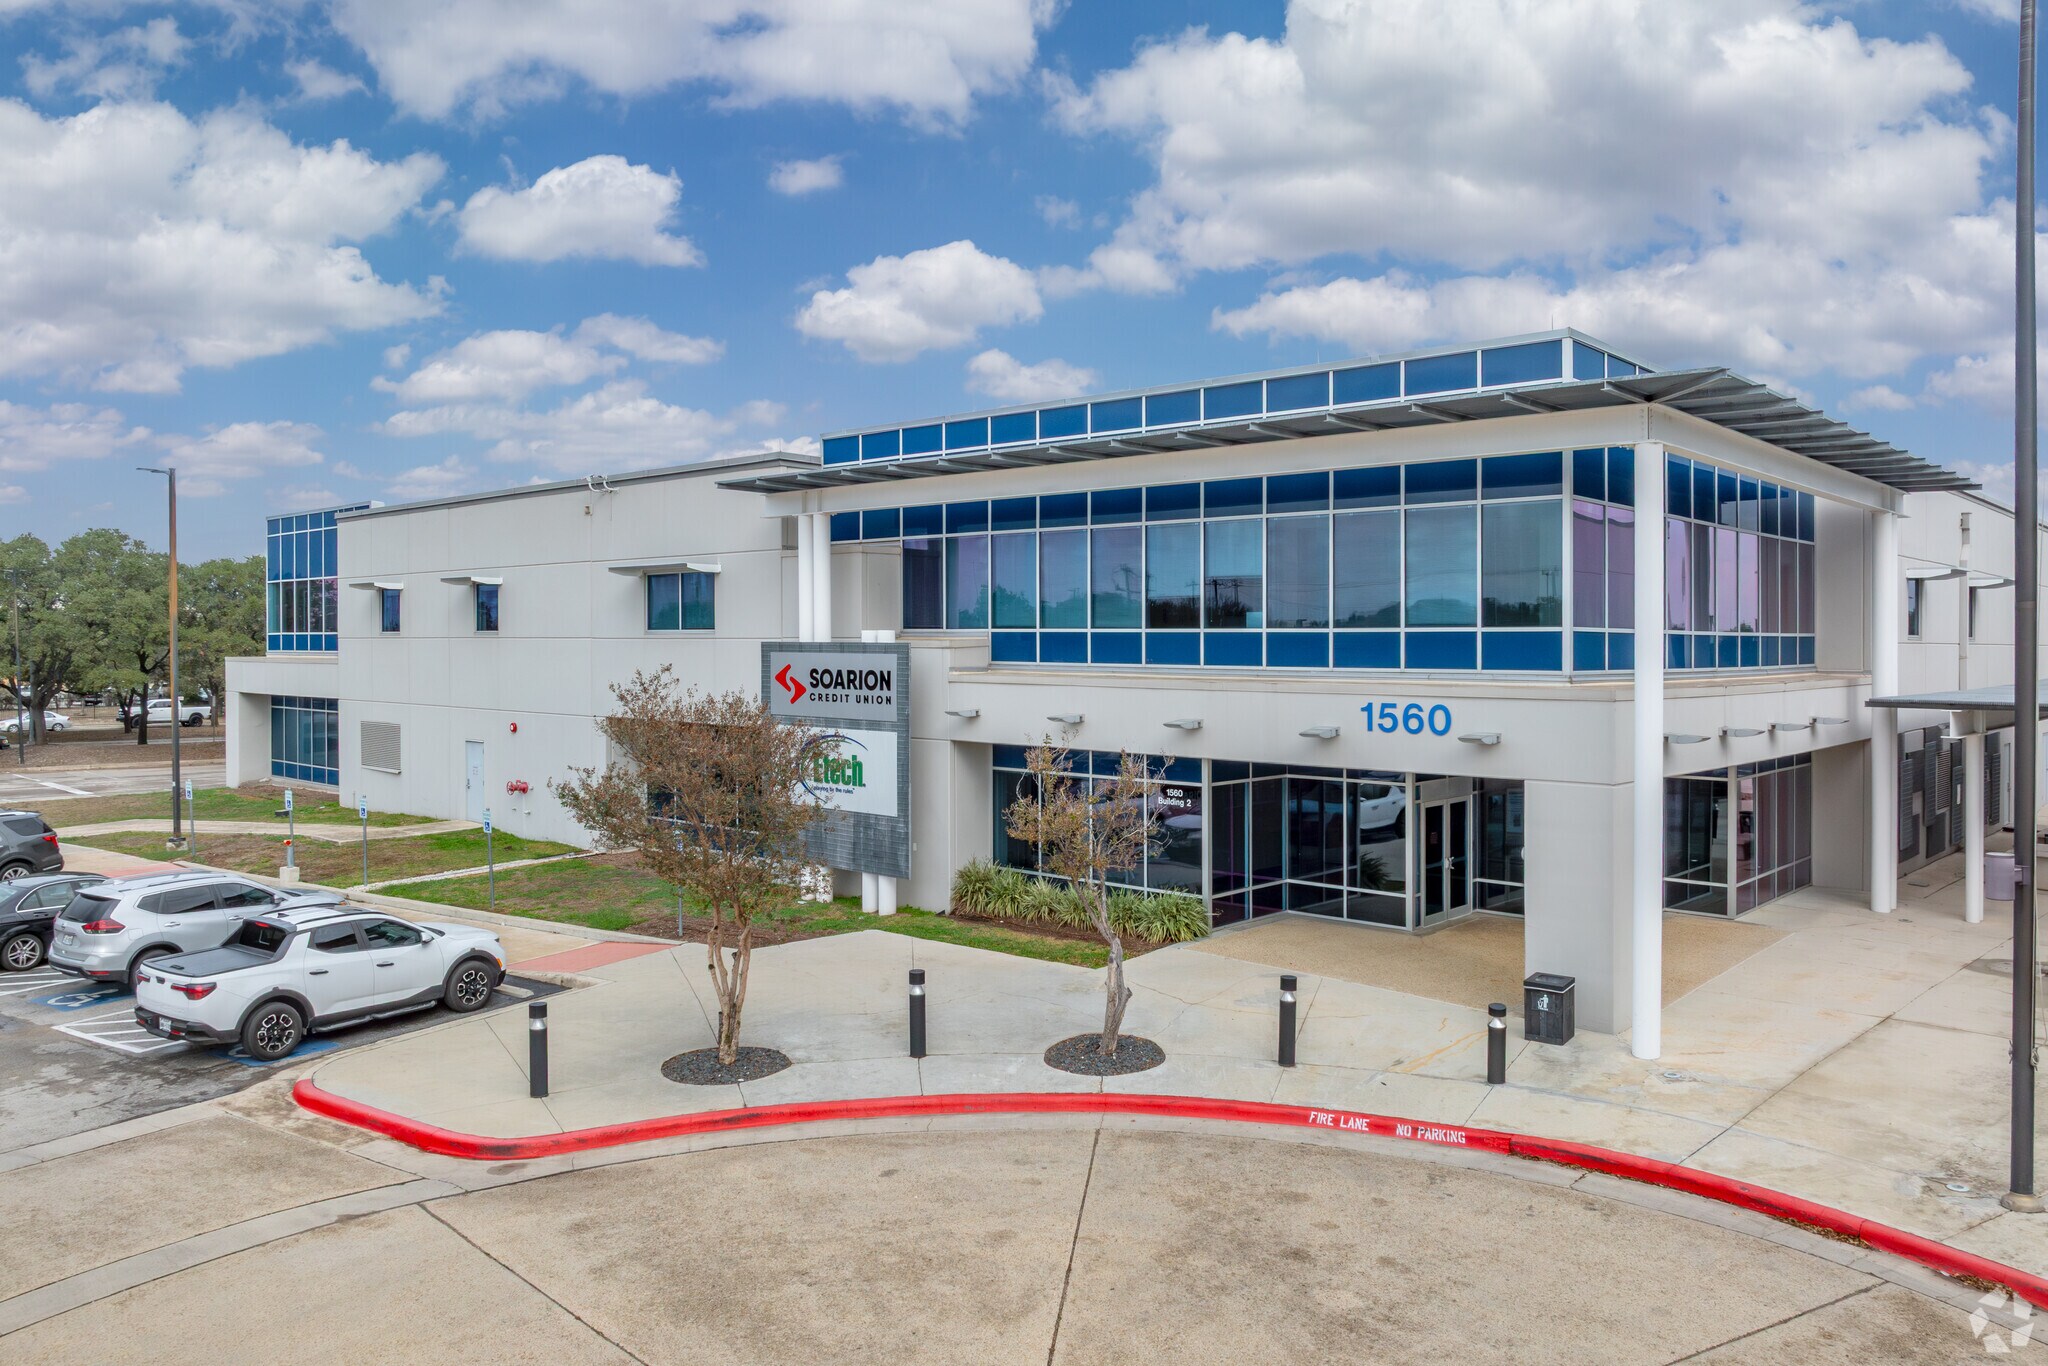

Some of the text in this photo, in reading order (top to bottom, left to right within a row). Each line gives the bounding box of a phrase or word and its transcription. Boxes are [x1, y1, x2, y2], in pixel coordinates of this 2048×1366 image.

[809, 668, 892, 691] SOARION
[809, 693, 892, 705] CREDIT UNION
[1360, 702, 1452, 737] 1560
[813, 754, 863, 787] Etech
[1158, 797, 1192, 807] Building 2
[1166, 789, 1183, 797] 1560
[1309, 1111, 1370, 1131] FIRE LANE
[1396, 1123, 1466, 1144] NO PARKING
